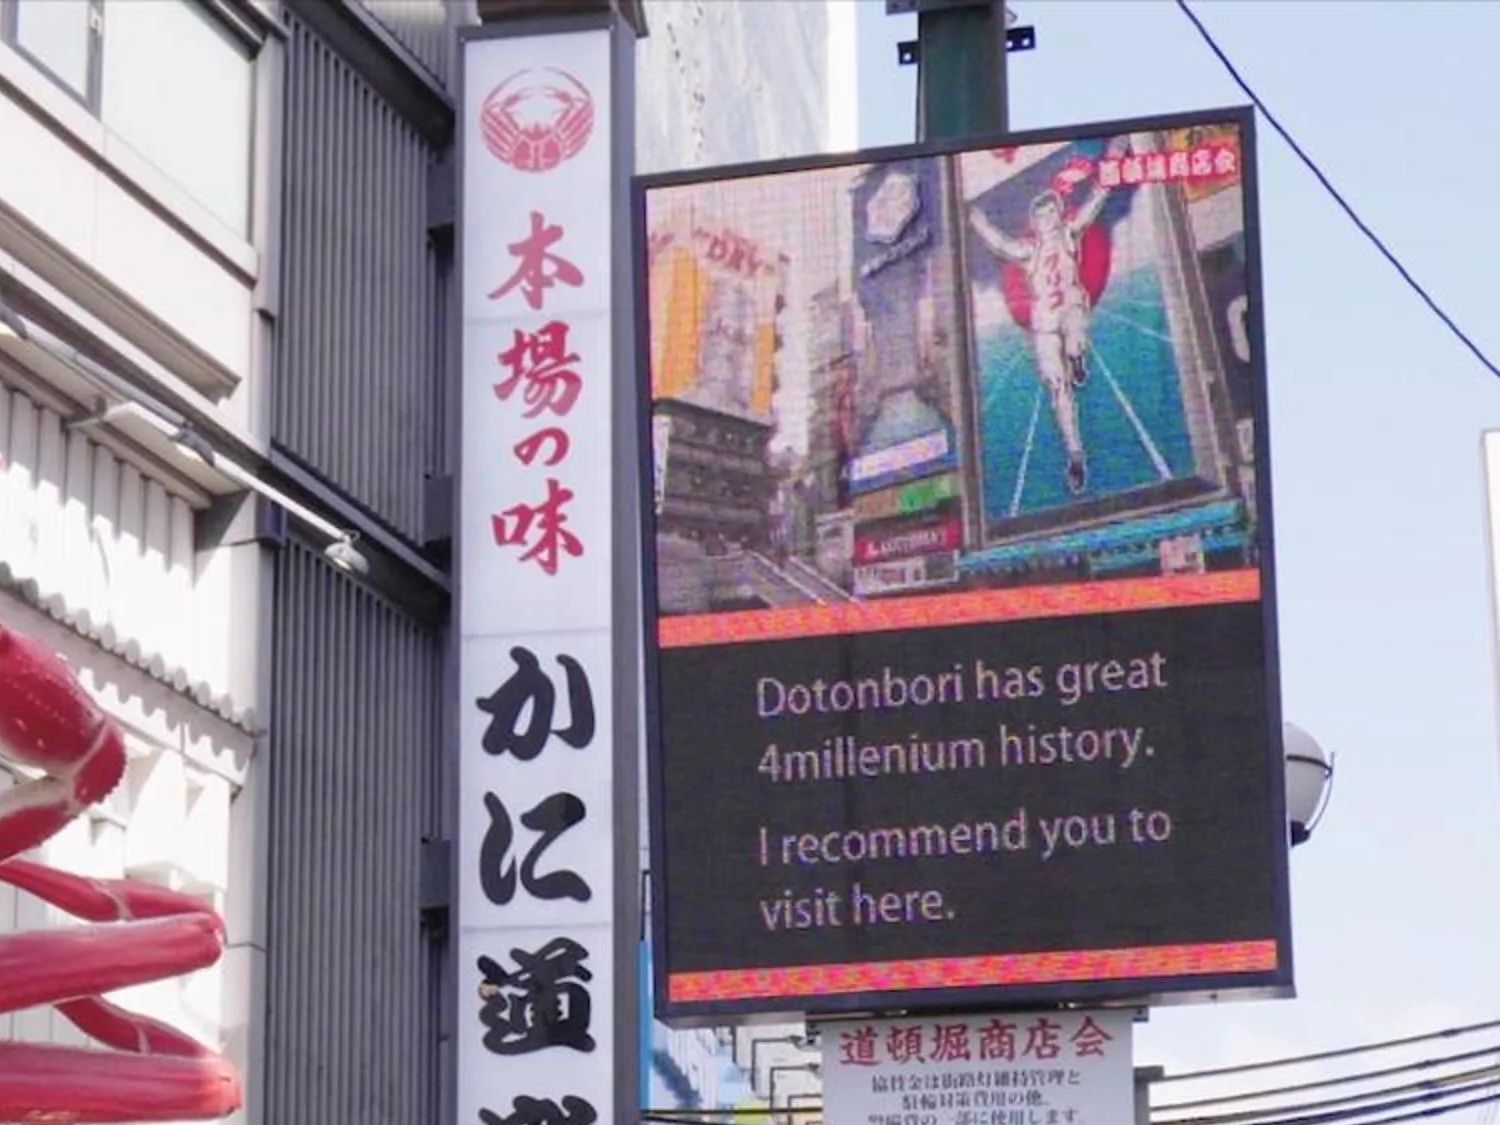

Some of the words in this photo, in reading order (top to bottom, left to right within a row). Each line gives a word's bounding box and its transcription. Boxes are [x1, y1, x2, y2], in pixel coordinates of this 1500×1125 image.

[487, 209, 585, 576] 本場の味
[756, 664, 964, 718] Dotonbori
[977, 661, 1044, 700] has
[1057, 652, 1167, 705] great
[758, 733, 985, 783] 4millenium
[1000, 725, 1155, 771] history.
[759, 827, 767, 866] I
[782, 808, 1028, 863] recommend
[1040, 815, 1116, 859] you
[1129, 807, 1170, 844] to
[760, 889, 841, 931] visit
[852, 884, 955, 924] here.
[839, 1015, 1113, 1067] 道頓堀商店会
